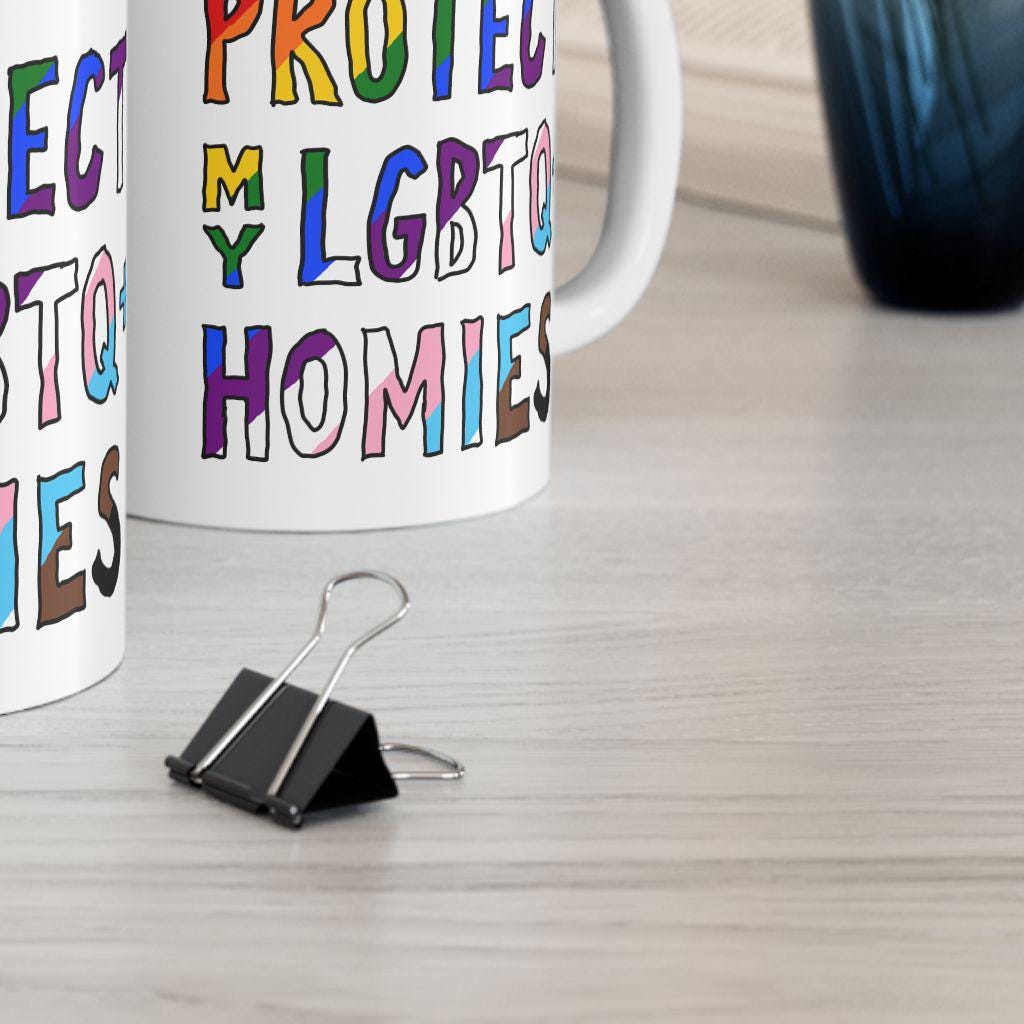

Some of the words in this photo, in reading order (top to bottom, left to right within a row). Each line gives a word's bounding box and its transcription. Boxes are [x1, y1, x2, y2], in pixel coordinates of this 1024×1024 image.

[202, 142, 265, 289] MY
[297, 118, 555, 287] LGBTQ
[201, 291, 552, 462] HOMIES
